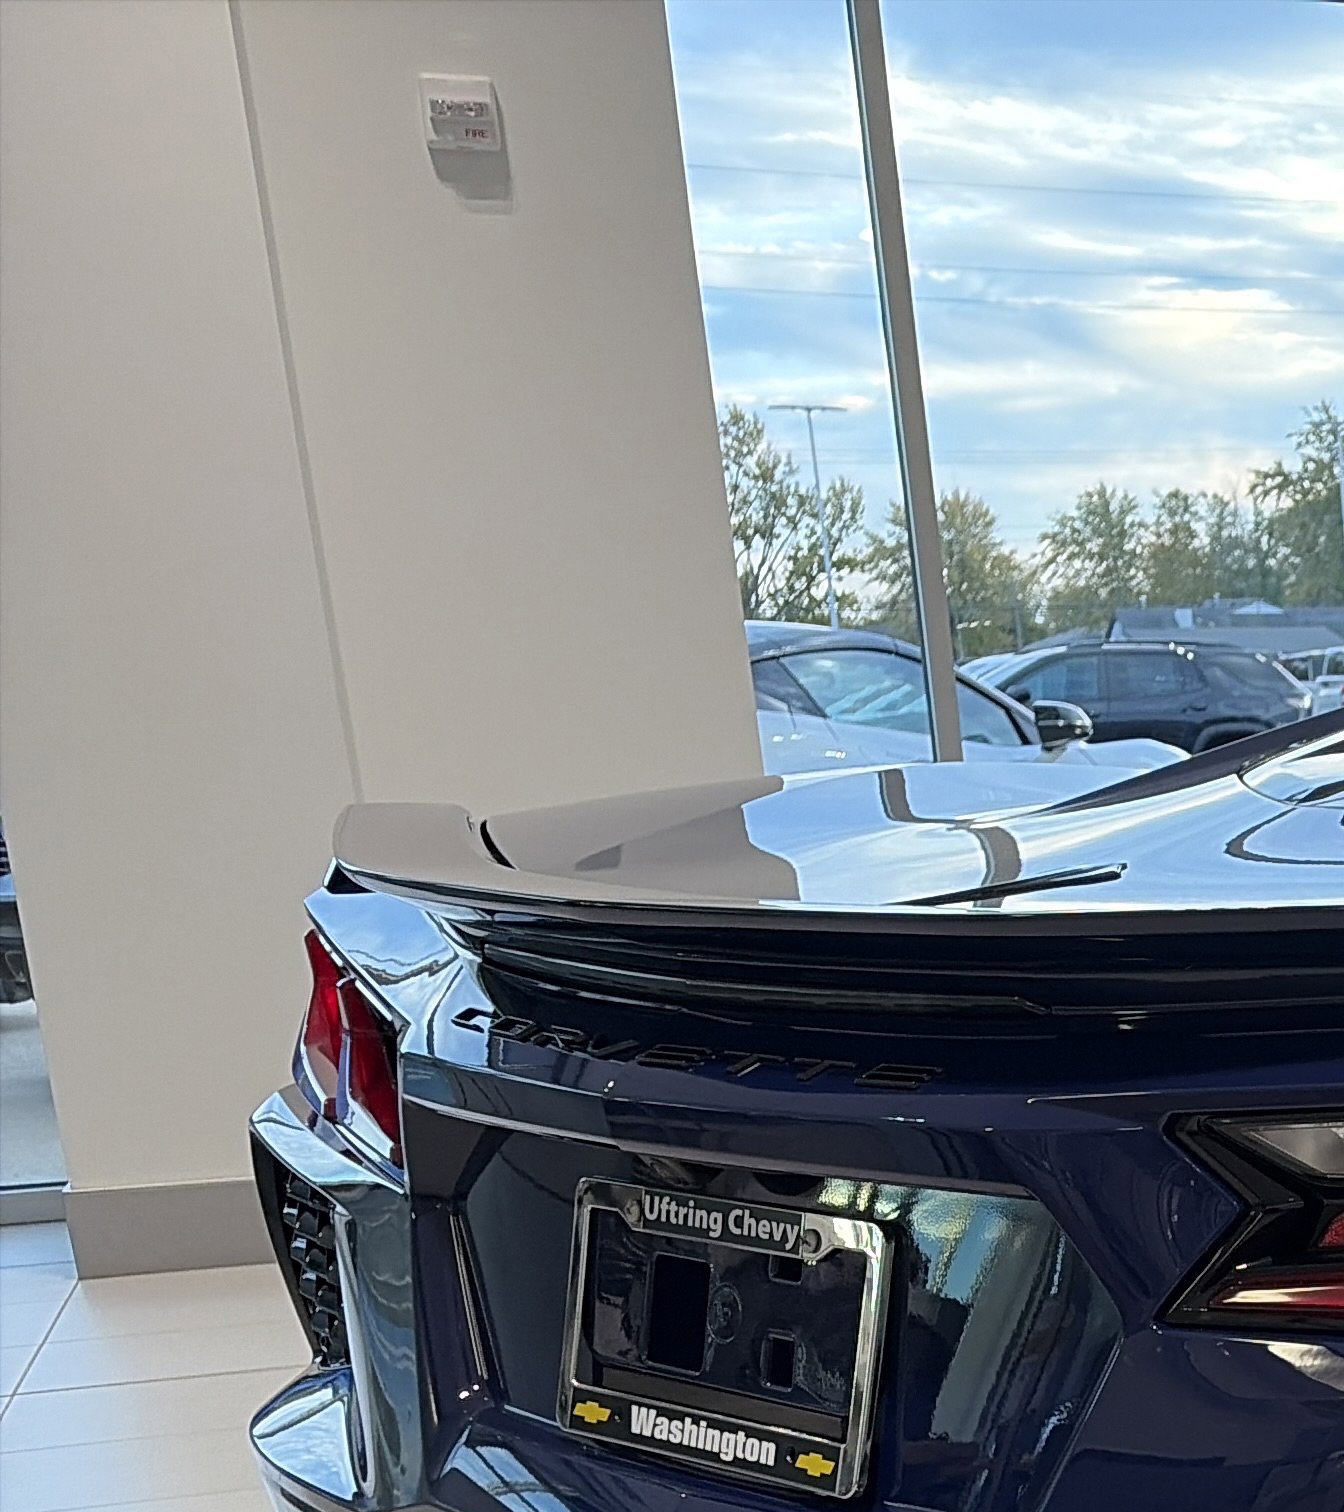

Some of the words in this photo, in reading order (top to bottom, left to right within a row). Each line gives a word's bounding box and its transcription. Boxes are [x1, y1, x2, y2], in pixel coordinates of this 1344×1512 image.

[465, 127, 489, 139] FIRE
[450, 1006, 944, 1090] CORVETTE
[643, 1193, 724, 1238] Uftring
[727, 1208, 800, 1250] Chevy
[630, 1404, 777, 1467] Washington
